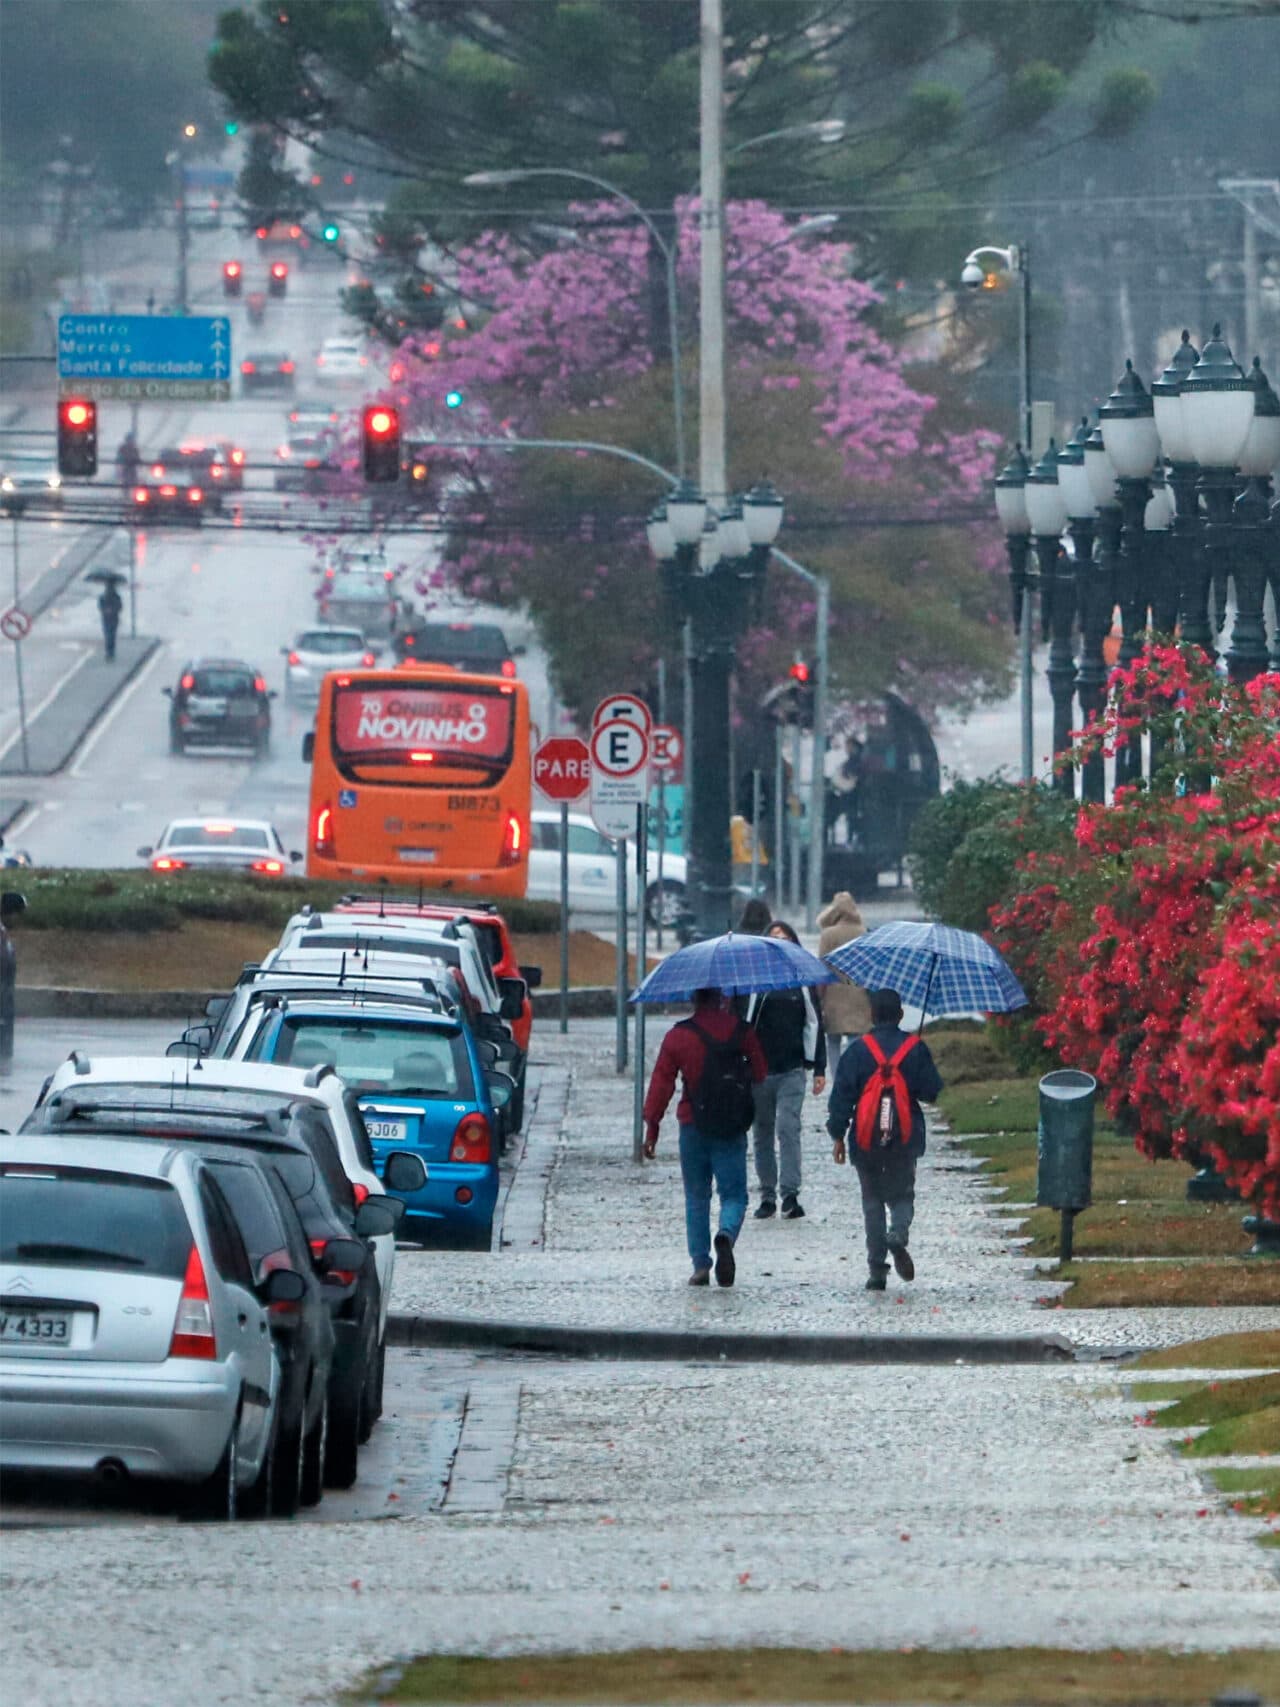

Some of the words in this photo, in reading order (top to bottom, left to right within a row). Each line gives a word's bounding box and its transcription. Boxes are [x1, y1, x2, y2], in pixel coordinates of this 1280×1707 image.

[61, 320, 128, 335] Centro
[61, 359, 112, 373] Santa
[118, 359, 203, 374] Felicidade
[358, 717, 487, 743] NOVINHO
[610, 732, 629, 764] E
